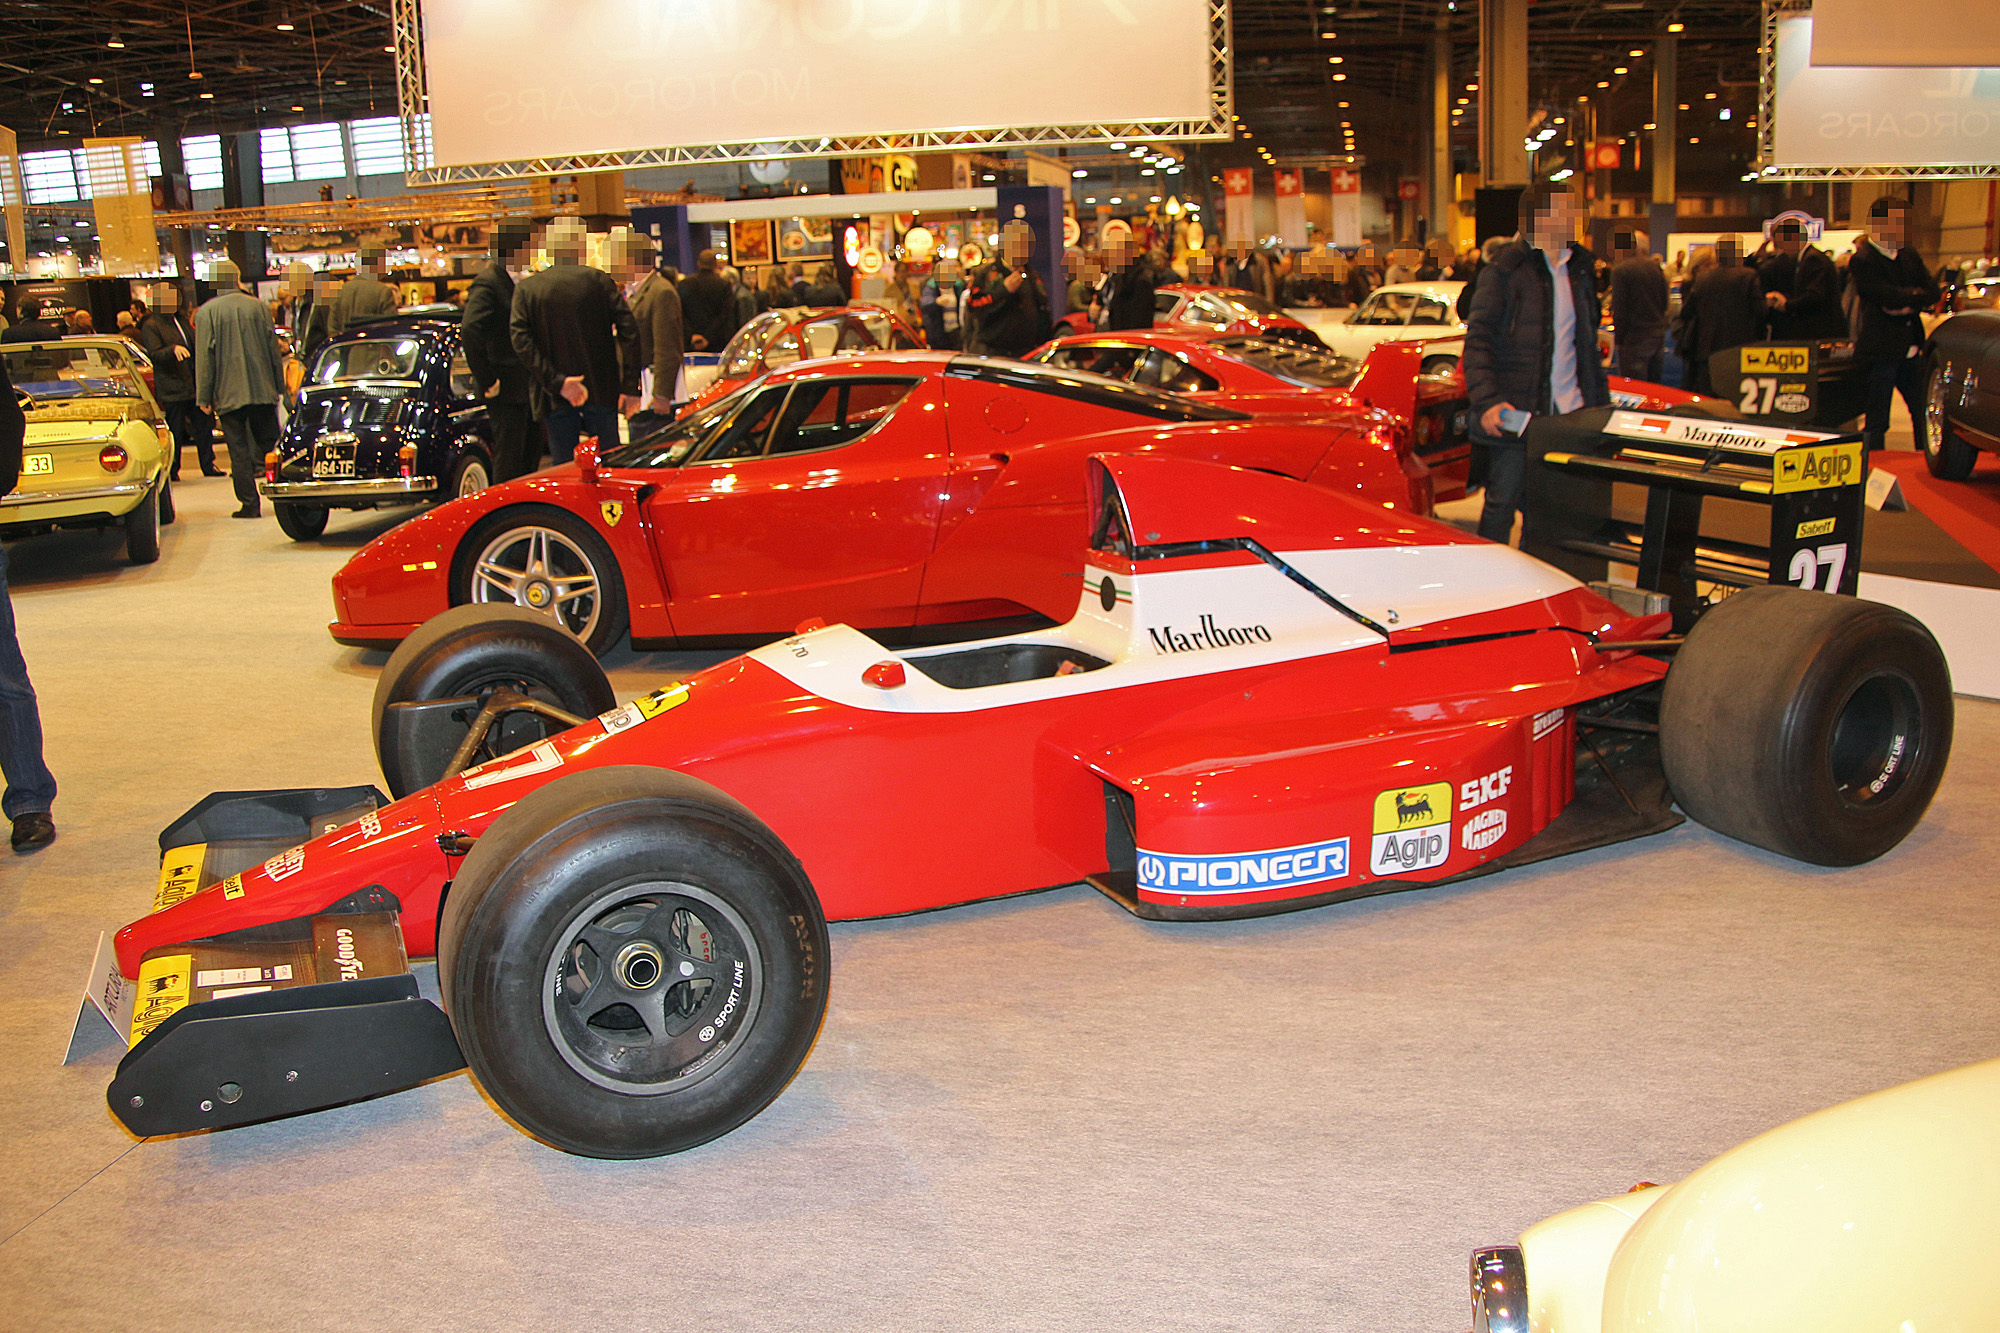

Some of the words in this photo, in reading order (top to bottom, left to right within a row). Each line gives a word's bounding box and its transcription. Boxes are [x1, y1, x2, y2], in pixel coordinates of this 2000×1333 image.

[1765, 350, 1805, 371] Agip
[1740, 377, 1778, 414] 27
[1679, 426, 1766, 450] Marlboro
[31, 456, 49, 471] 33
[1801, 449, 1852, 485] Agip
[1788, 543, 1848, 594] 27
[1147, 614, 1272, 655] Marlboro
[1459, 765, 1513, 811] SKF
[1169, 846, 1345, 887] PIONEER
[1380, 830, 1443, 869] Agip
[333, 928, 364, 982] GOODYE
[714, 990, 740, 1029] SPORT
[734, 960, 744, 989] LINE
